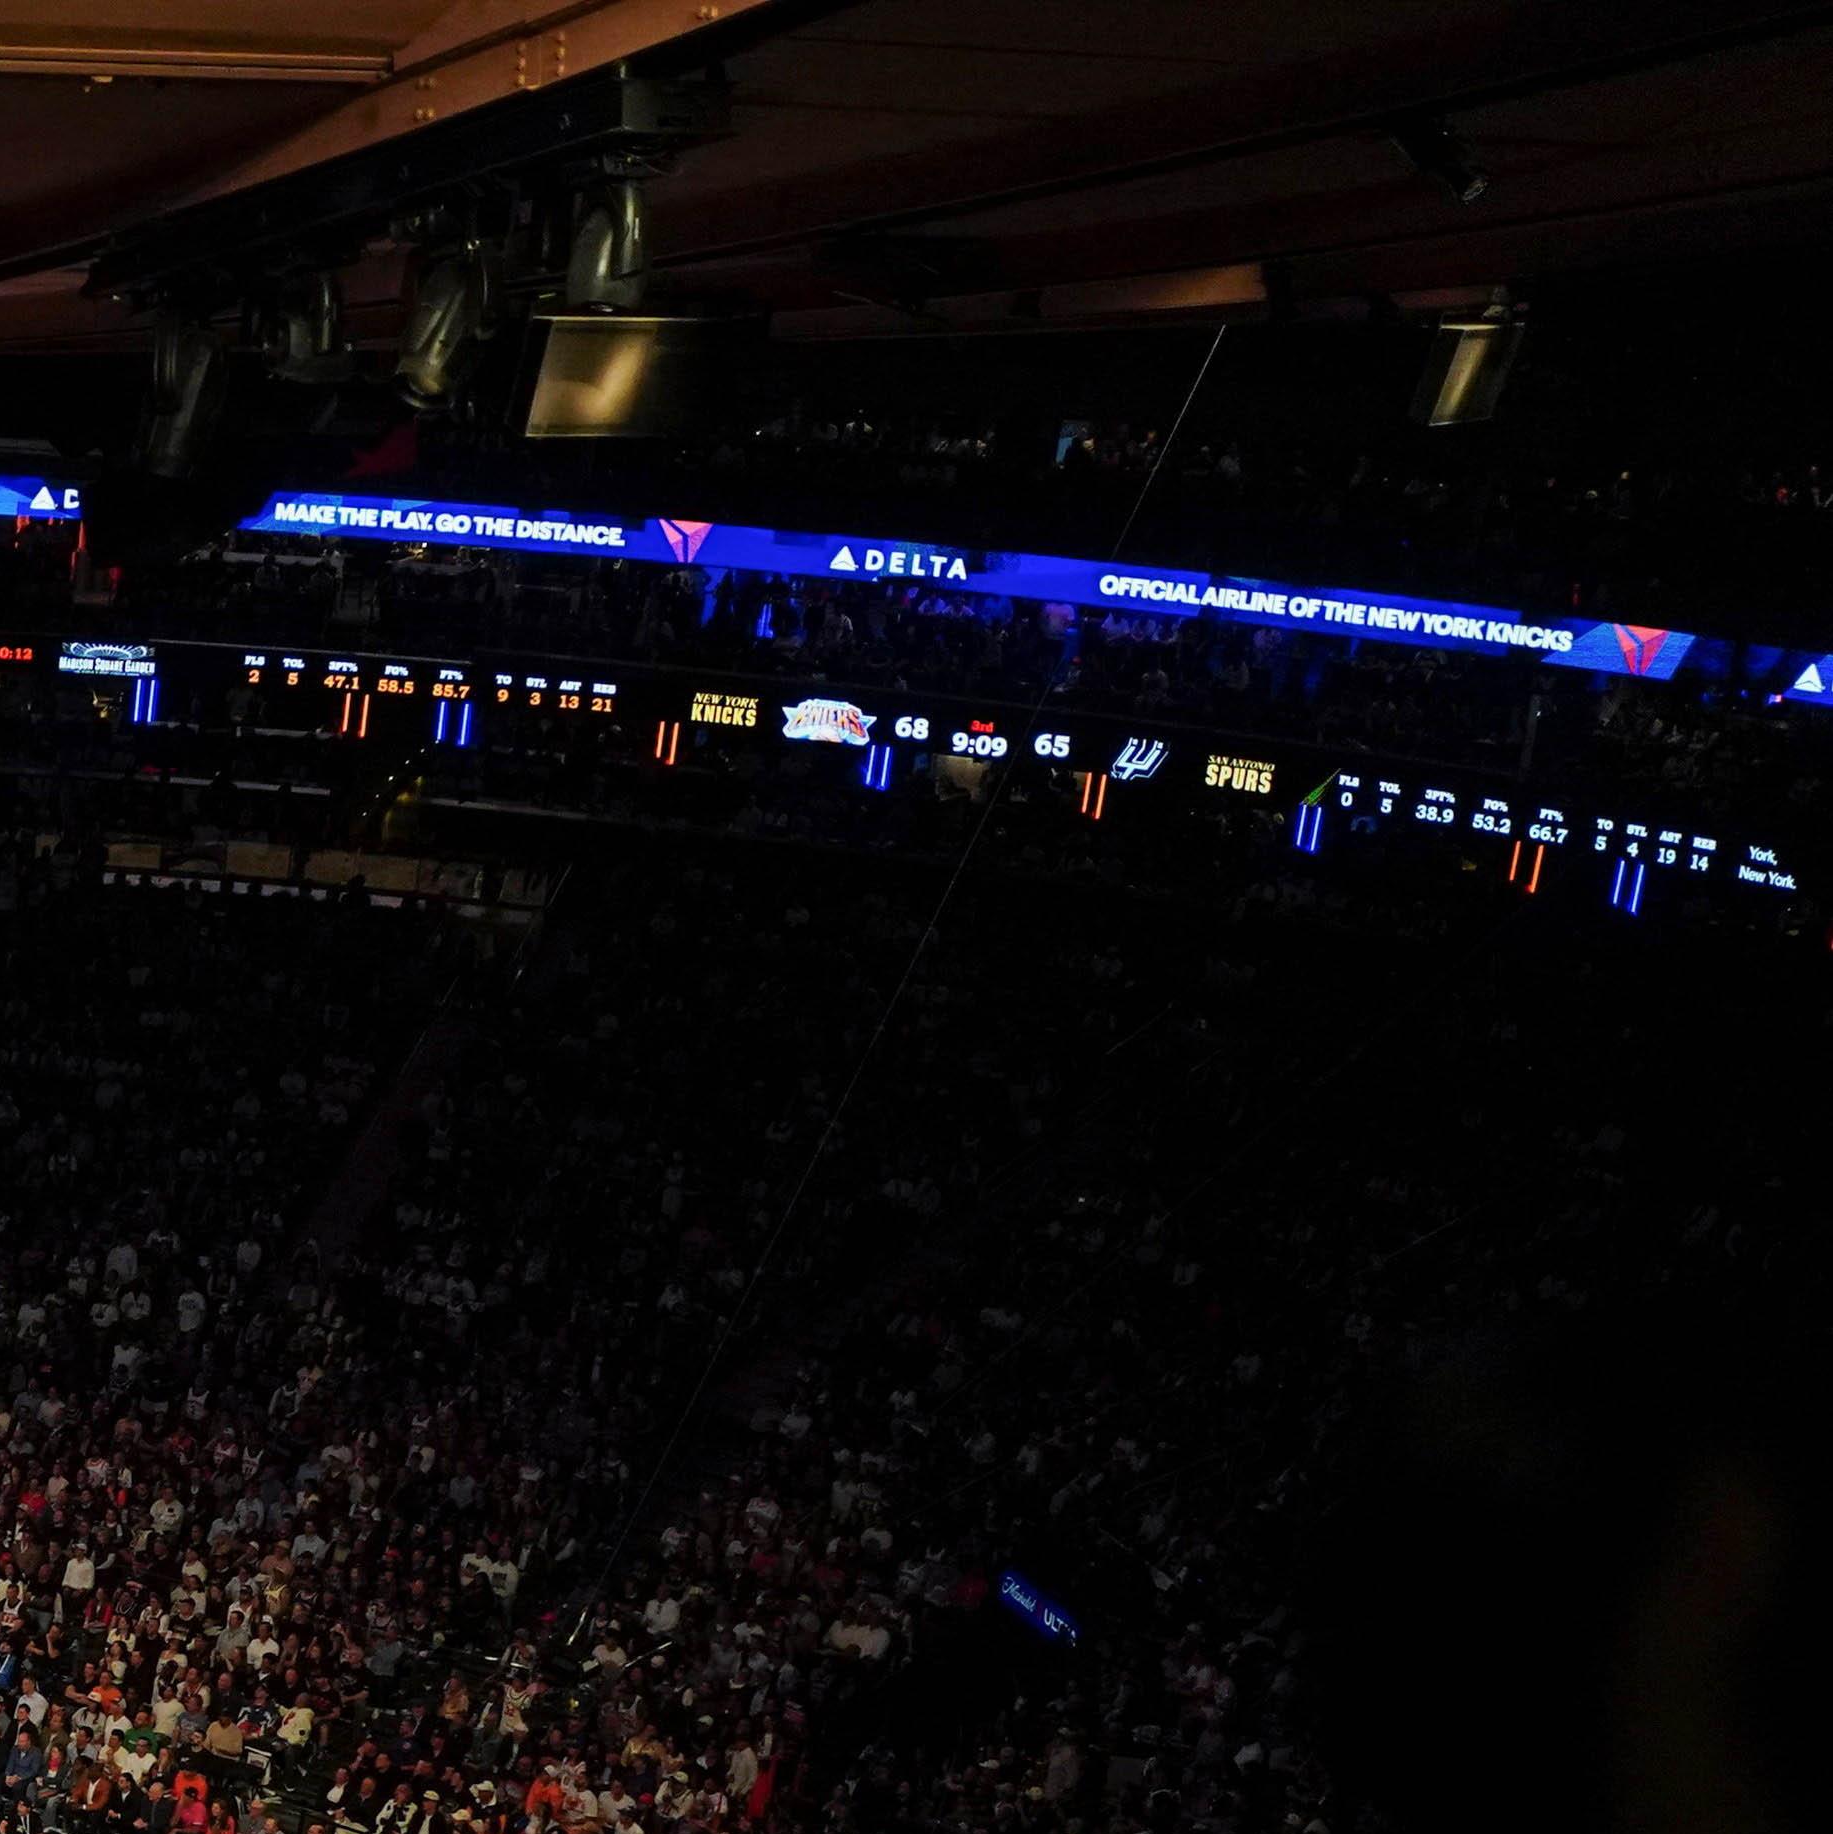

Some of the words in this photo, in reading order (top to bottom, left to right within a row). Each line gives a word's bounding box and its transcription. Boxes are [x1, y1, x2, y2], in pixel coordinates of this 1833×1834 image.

[274, 502, 336, 525] MAKE
[336, 506, 379, 528] THE
[380, 509, 434, 532] PLAY.
[435, 513, 472, 535] GO
[473, 516, 517, 539] THE
[518, 519, 625, 547] DISTANCE.
[864, 548, 968, 581] DELTA
[1099, 574, 1200, 606] OFFICIAL
[1200, 586, 1286, 616] AIRLINE
[1288, 596, 1322, 620] OF
[1323, 599, 1367, 626] THE
[1368, 606, 1421, 632] NEW
[1421, 612, 1486, 641] YORK
[1486, 620, 1574, 653] KNICKS
[323, 675, 360, 691] 47.1
[376, 678, 415, 695] 58.5
[432, 683, 470, 700] 85.7
[559, 694, 581, 709] 13
[590, 697, 613, 713] 21
[692, 692, 724, 705] NEW
[725, 694, 759, 710] YORK
[690, 702, 757, 728] KNICKS
[894, 715, 930, 740] 68
[970, 719, 994, 733] 3rd
[951, 731, 1008, 757] 9:09
[1033, 732, 1071, 758] 65
[1207, 754, 1229, 766] SAN
[1204, 764, 1273, 794] SPURS
[1424, 788, 1456, 804] 3PT%
[1415, 804, 1455, 824] 38.9
[1471, 814, 1512, 834] 53.2
[1528, 823, 1569, 844] 66.7
[1596, 818, 1614, 832] TO
[1658, 830, 1682, 844] AST
[1657, 847, 1677, 865] 19
[1690, 853, 1709, 872] 14
[1737, 864, 1767, 884] New
